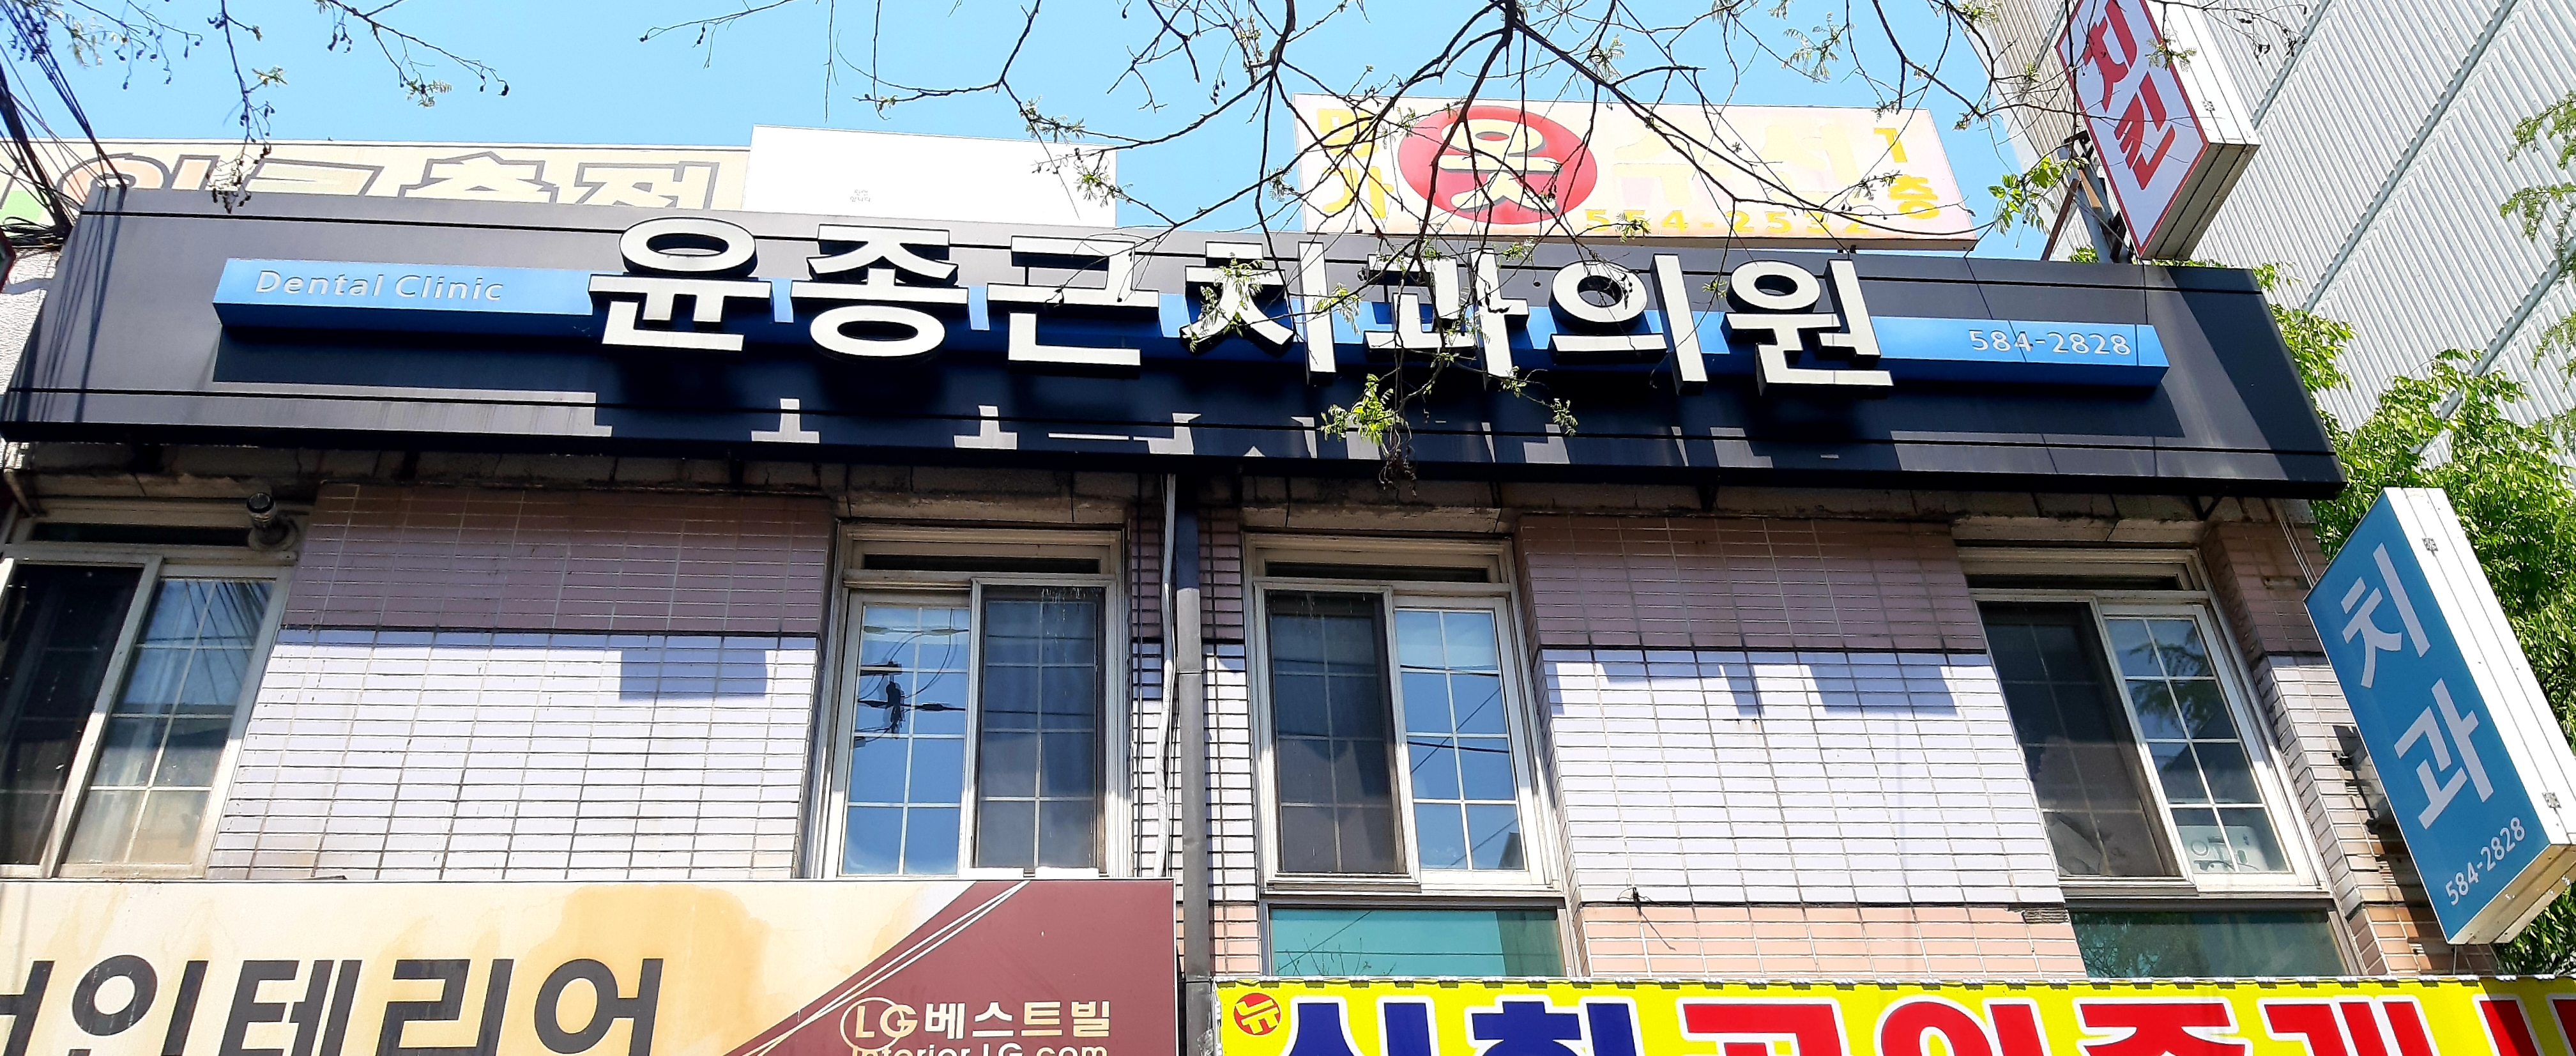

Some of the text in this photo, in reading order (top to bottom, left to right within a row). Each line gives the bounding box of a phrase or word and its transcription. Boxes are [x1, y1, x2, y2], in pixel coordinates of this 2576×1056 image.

[2082, 0, 2176, 190] 치킨
[1873, 128, 1940, 220] 1층
[255, 270, 504, 302] Dental Clinic
[588, 216, 1893, 388] 윤종근치과의원
[1969, 328, 2132, 356] 584-2828
[2340, 542, 2495, 830] 치과
[2445, 816, 2525, 906] 584-2828
[0, 954, 664, 1056] 인테리어
